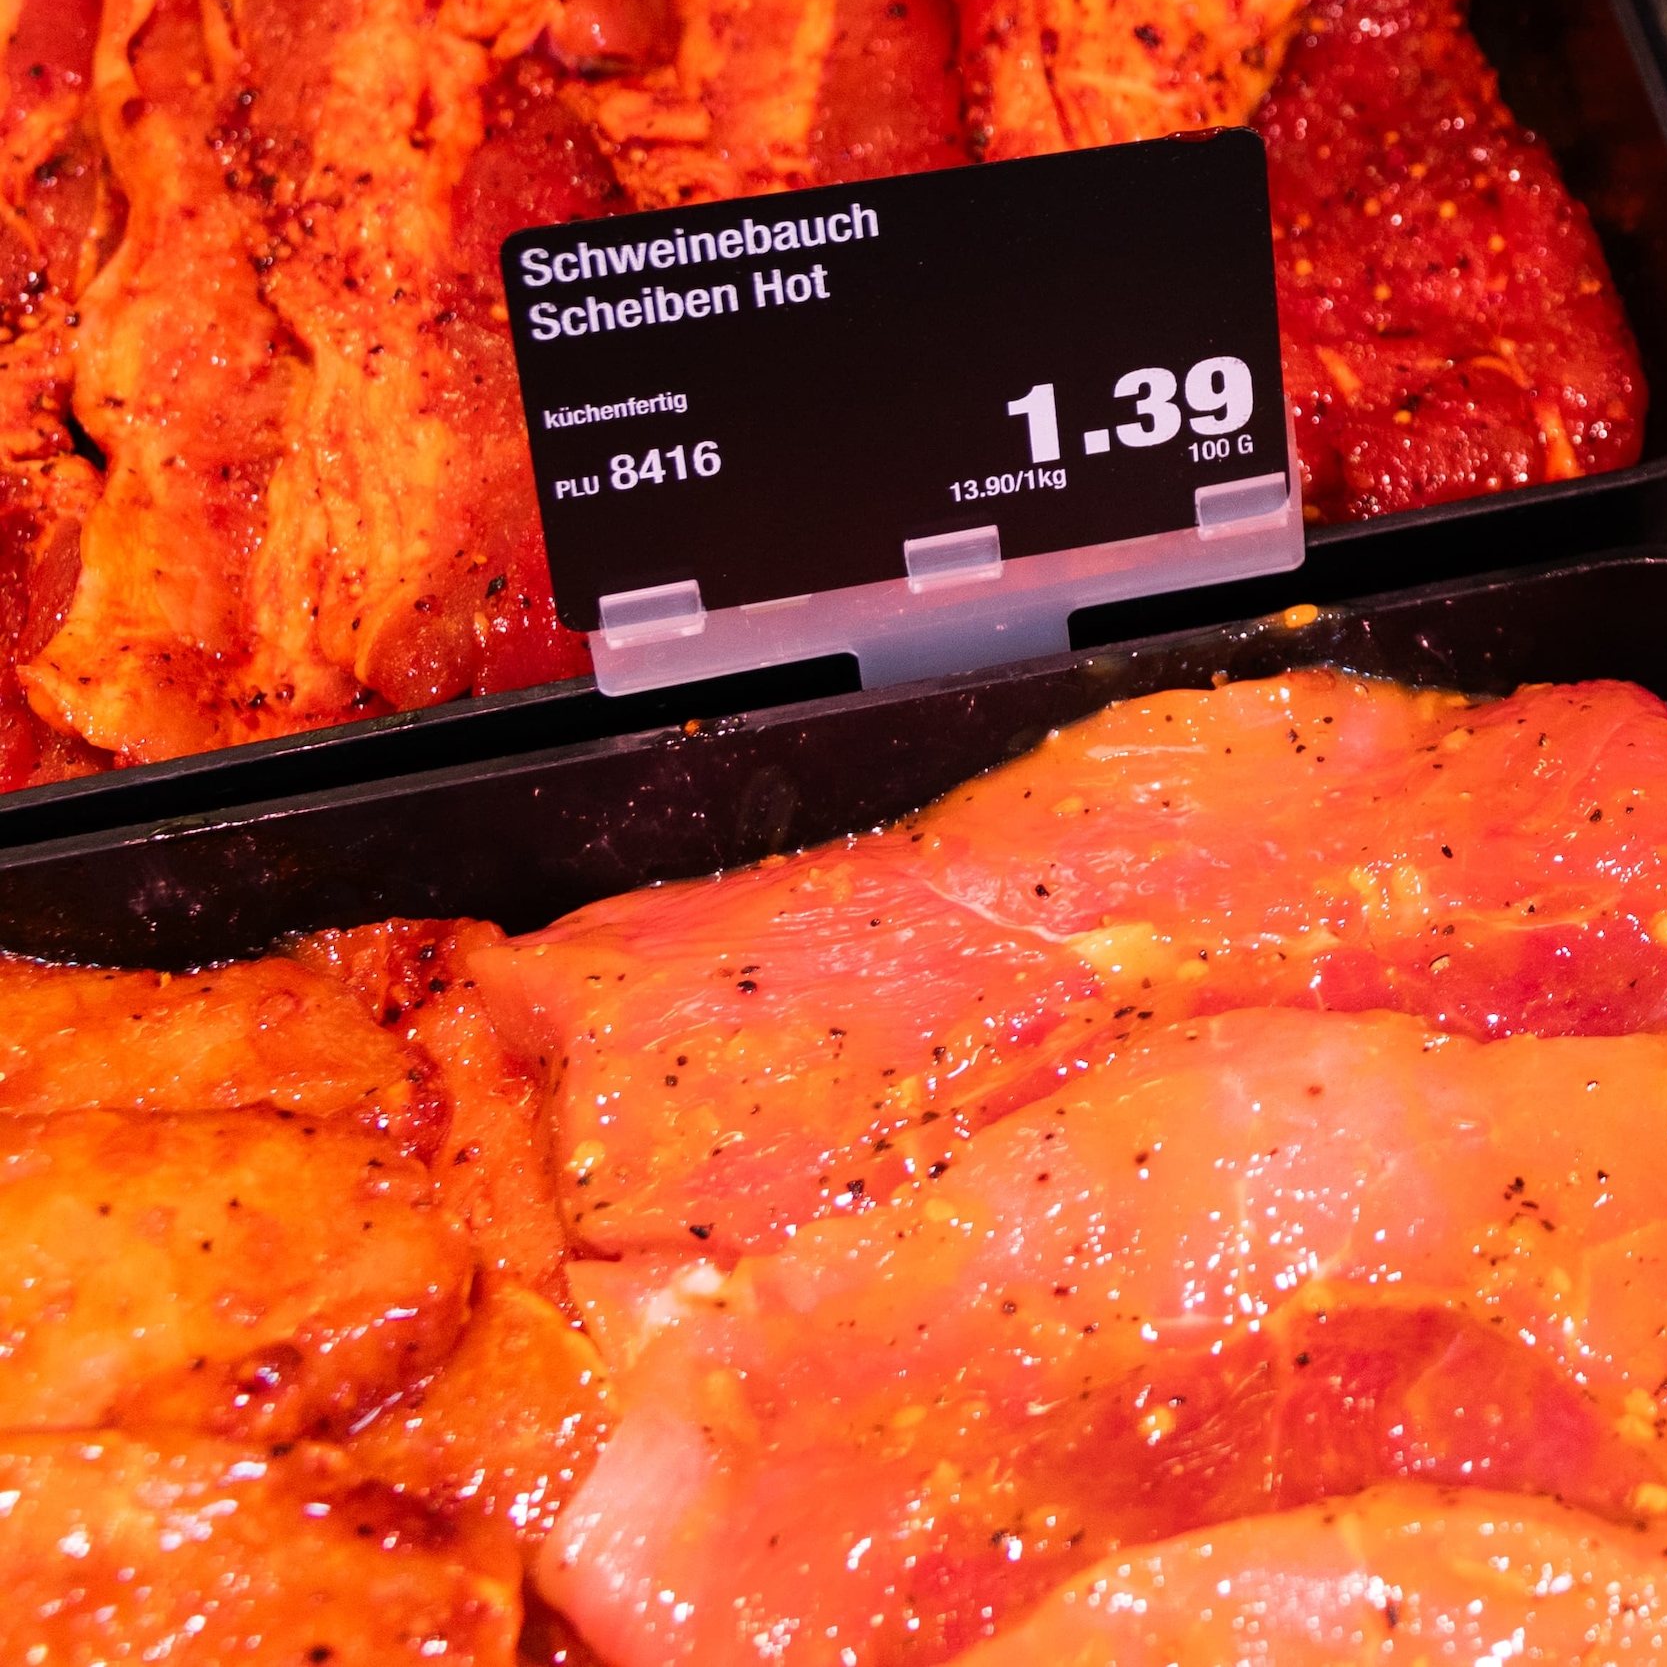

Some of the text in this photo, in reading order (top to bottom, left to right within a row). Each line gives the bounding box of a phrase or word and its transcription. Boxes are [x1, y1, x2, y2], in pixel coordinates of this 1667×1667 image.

[519, 203, 880, 287] Schweinebauch
[528, 263, 830, 341] Scheiben Hot
[543, 392, 688, 429] küchenfertig
[1006, 355, 1254, 464] 1.39
[555, 439, 723, 500] PLU 8416
[1188, 433, 1254, 463] 100 G
[948, 467, 1067, 502] 13.90/1kg
